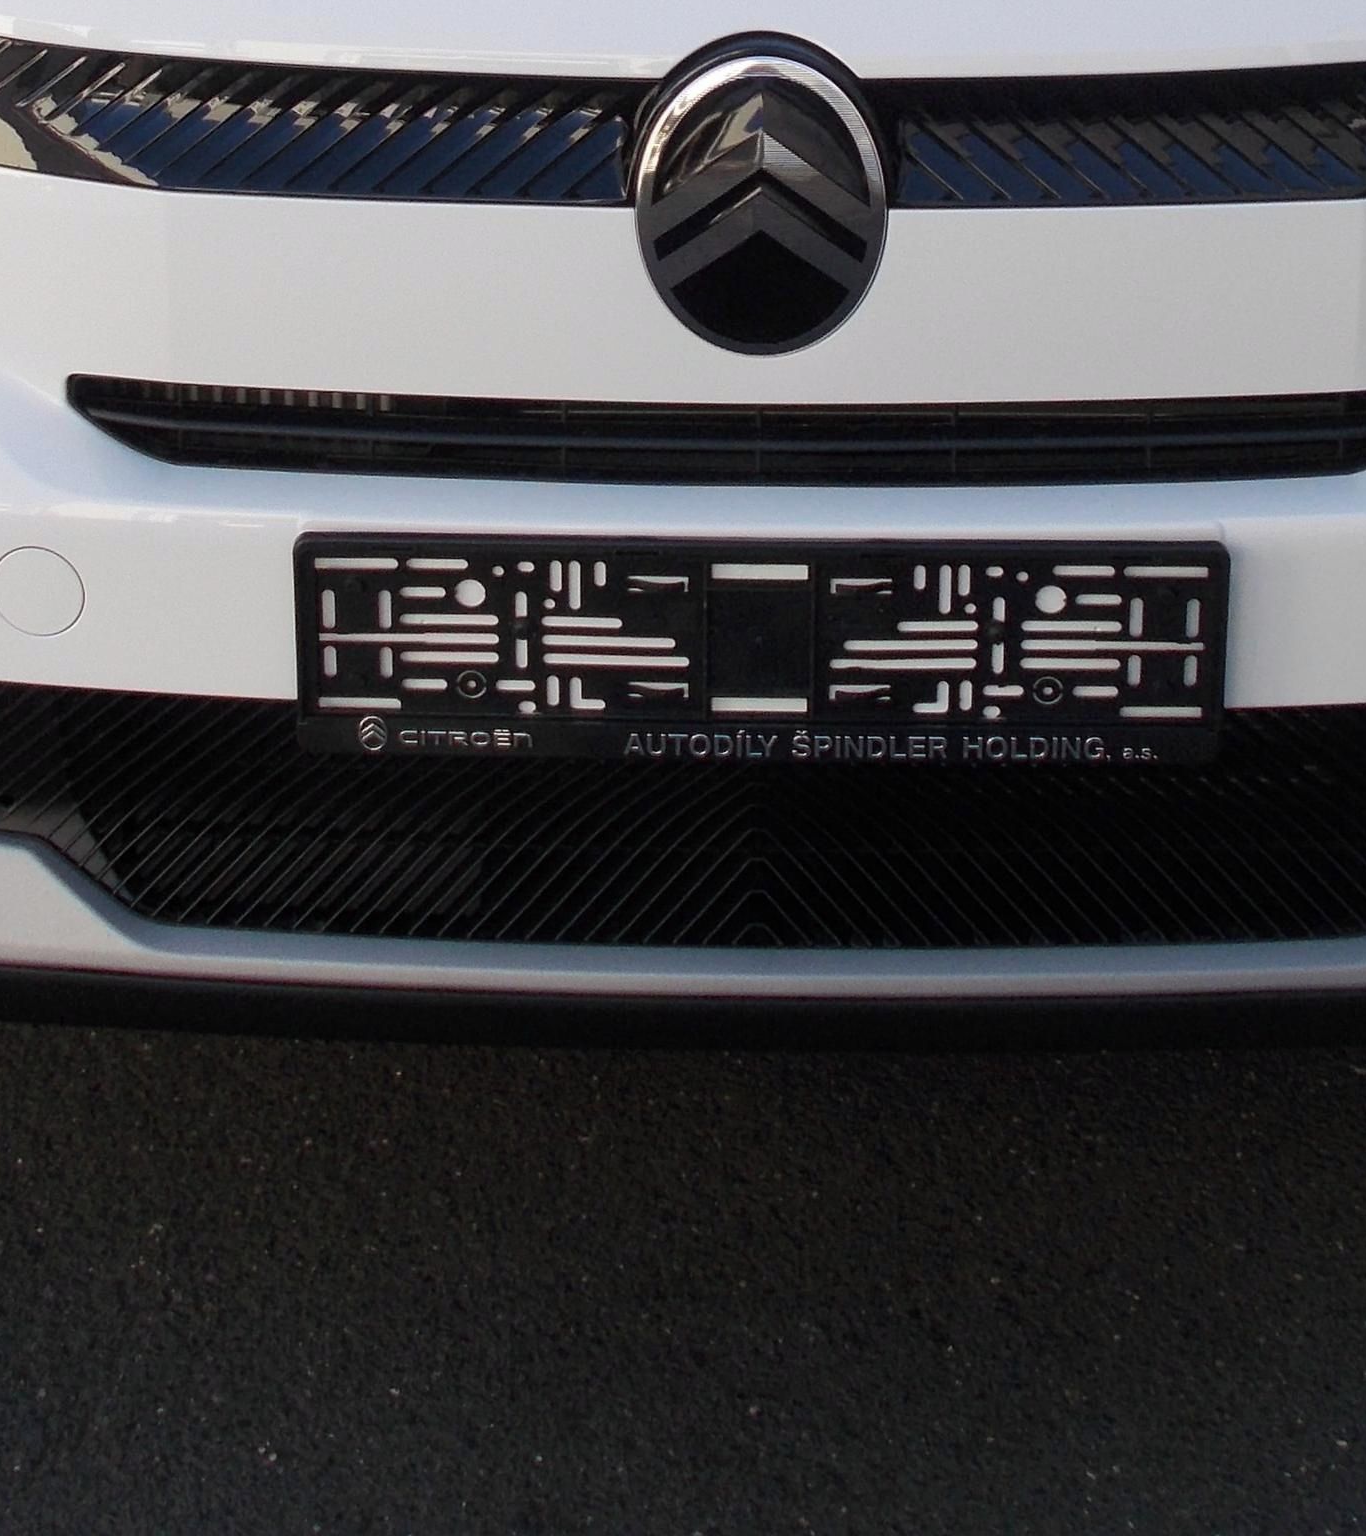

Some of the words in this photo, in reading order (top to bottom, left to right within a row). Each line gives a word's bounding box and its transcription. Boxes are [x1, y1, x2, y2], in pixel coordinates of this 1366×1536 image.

[623, 729, 778, 758] AUTODÍLY
[791, 730, 948, 759] ŠPINDLER
[1122, 747, 1158, 760] a.s.
